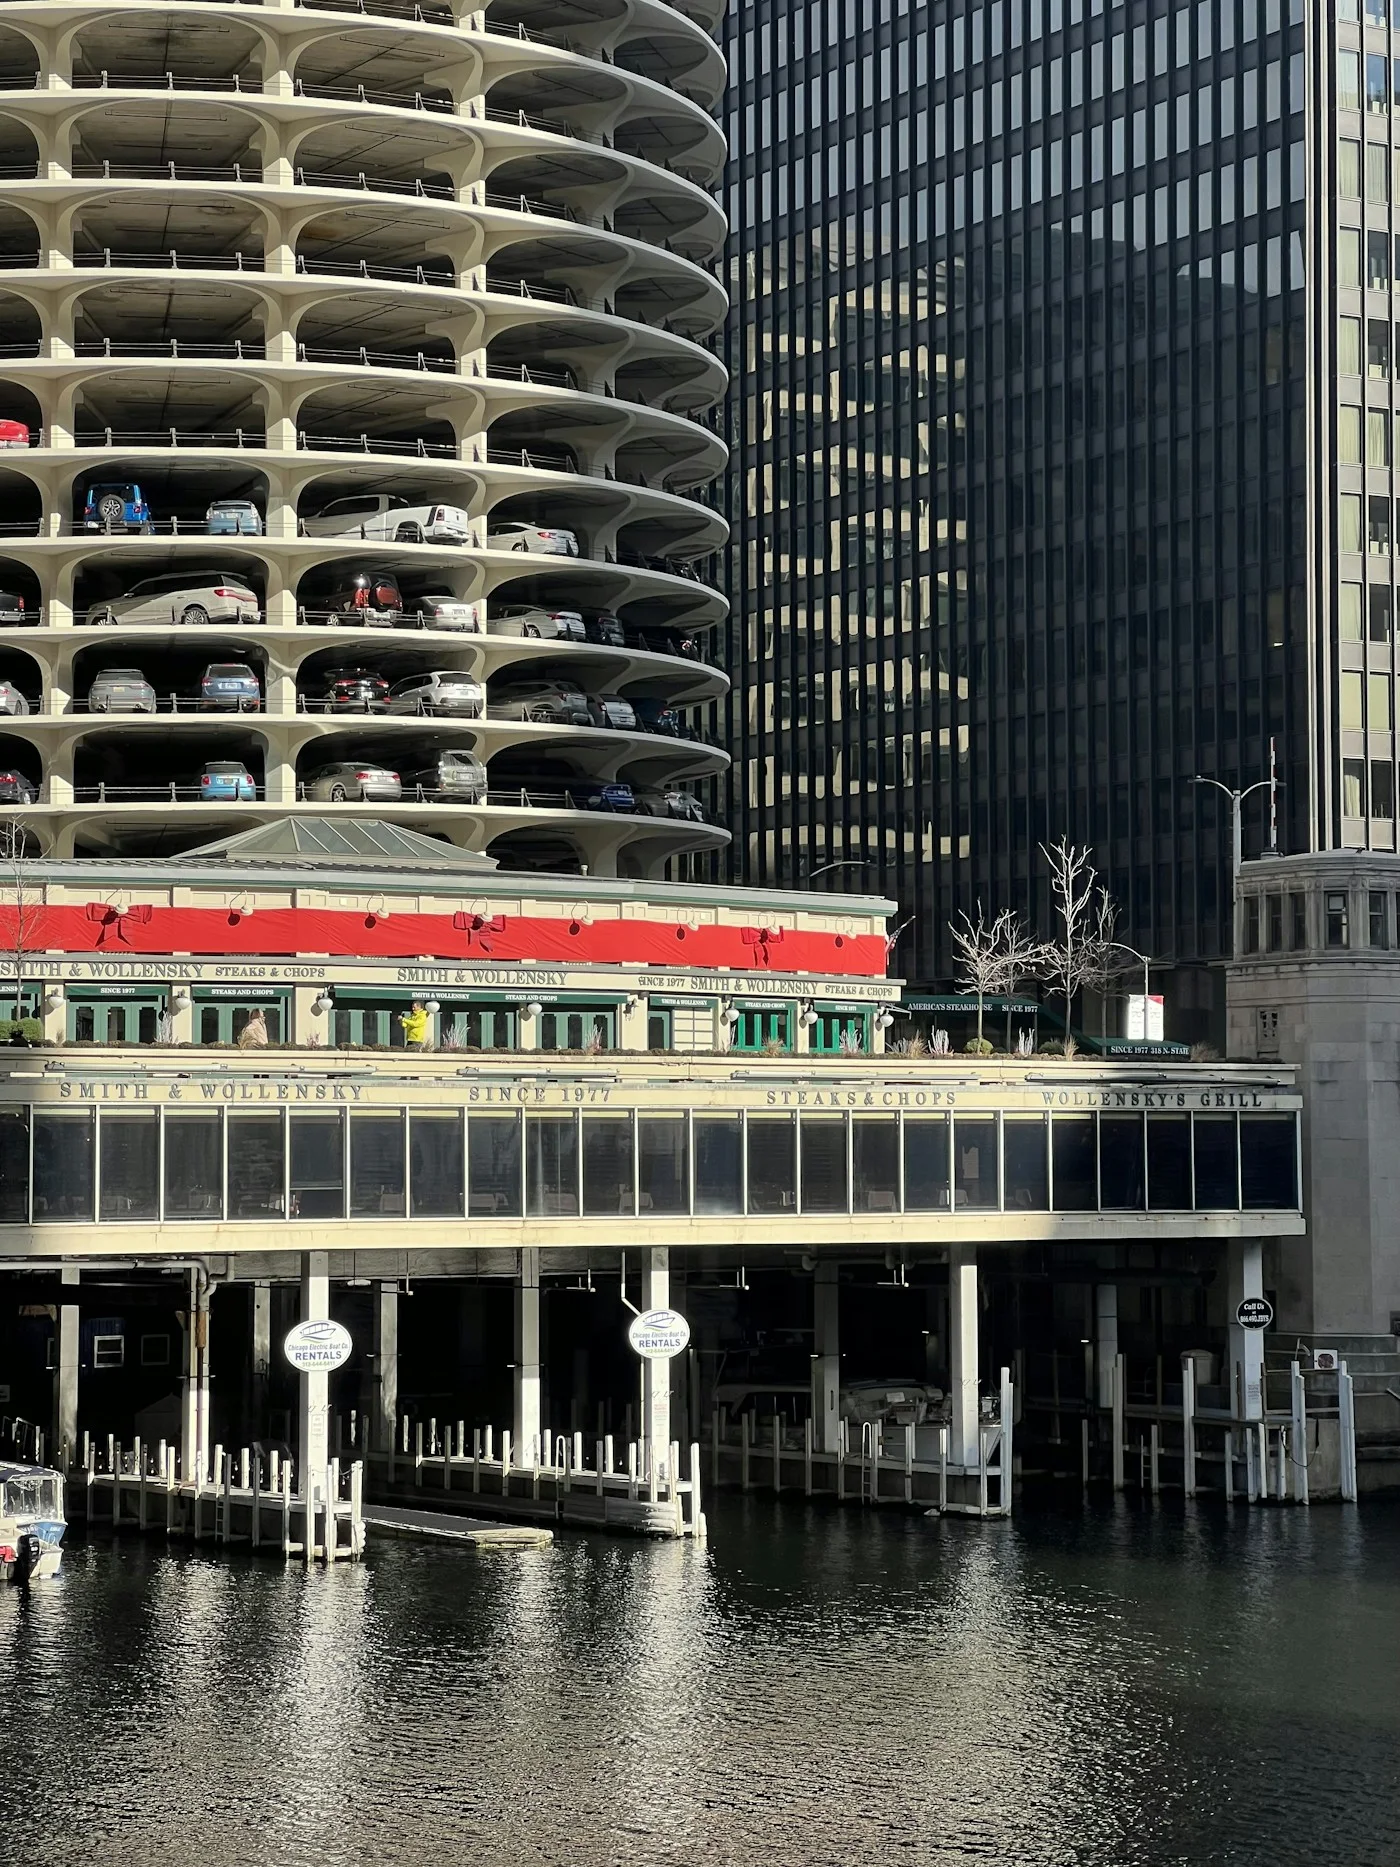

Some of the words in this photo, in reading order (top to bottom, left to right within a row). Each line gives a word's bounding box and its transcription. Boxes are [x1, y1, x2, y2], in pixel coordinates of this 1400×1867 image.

[0, 962, 61, 976] SMITH
[69, 963, 82, 977] &
[89, 962, 204, 978] WOLLENSKY
[215, 967, 266, 977] STEAKS
[270, 967, 279, 977] &
[283, 967, 325, 977] CHOPS
[398, 968, 448, 982] SMITH
[454, 969, 466, 983] &
[472, 970, 567, 985] WOLLENSKY
[638, 976, 664, 986] SINCE
[667, 978, 685, 987] 1977
[690, 977, 729, 991] SMITH
[734, 978, 743, 991] &
[747, 979, 818, 995] WOLLENSKY
[825, 985, 856, 994] STEAKS
[859, 987, 865, 995] &
[867, 987, 893, 996] CHOPS
[907, 1003, 945, 1011] AMERICA'S
[946, 1003, 992, 1011] STEAKHOSE
[1111, 1046, 1133, 1054] SINCE
[1134, 1046, 1148, 1054] 1977
[1171, 1047, 1189, 1055] STATE
[60, 1083, 148, 1099] SMITH
[169, 1084, 182, 1099] &
[200, 1082, 362, 1100] WOLLENSKY
[469, 1086, 546, 1101] SINCE
[561, 1087, 611, 1102] 1977
[1042, 1092, 1186, 1107] WOLLENSKY'S
[1200, 1093, 1262, 1107] GRILL
[639, 1339, 681, 1348] RENTALS
[295, 1351, 342, 1360] RENTALS
